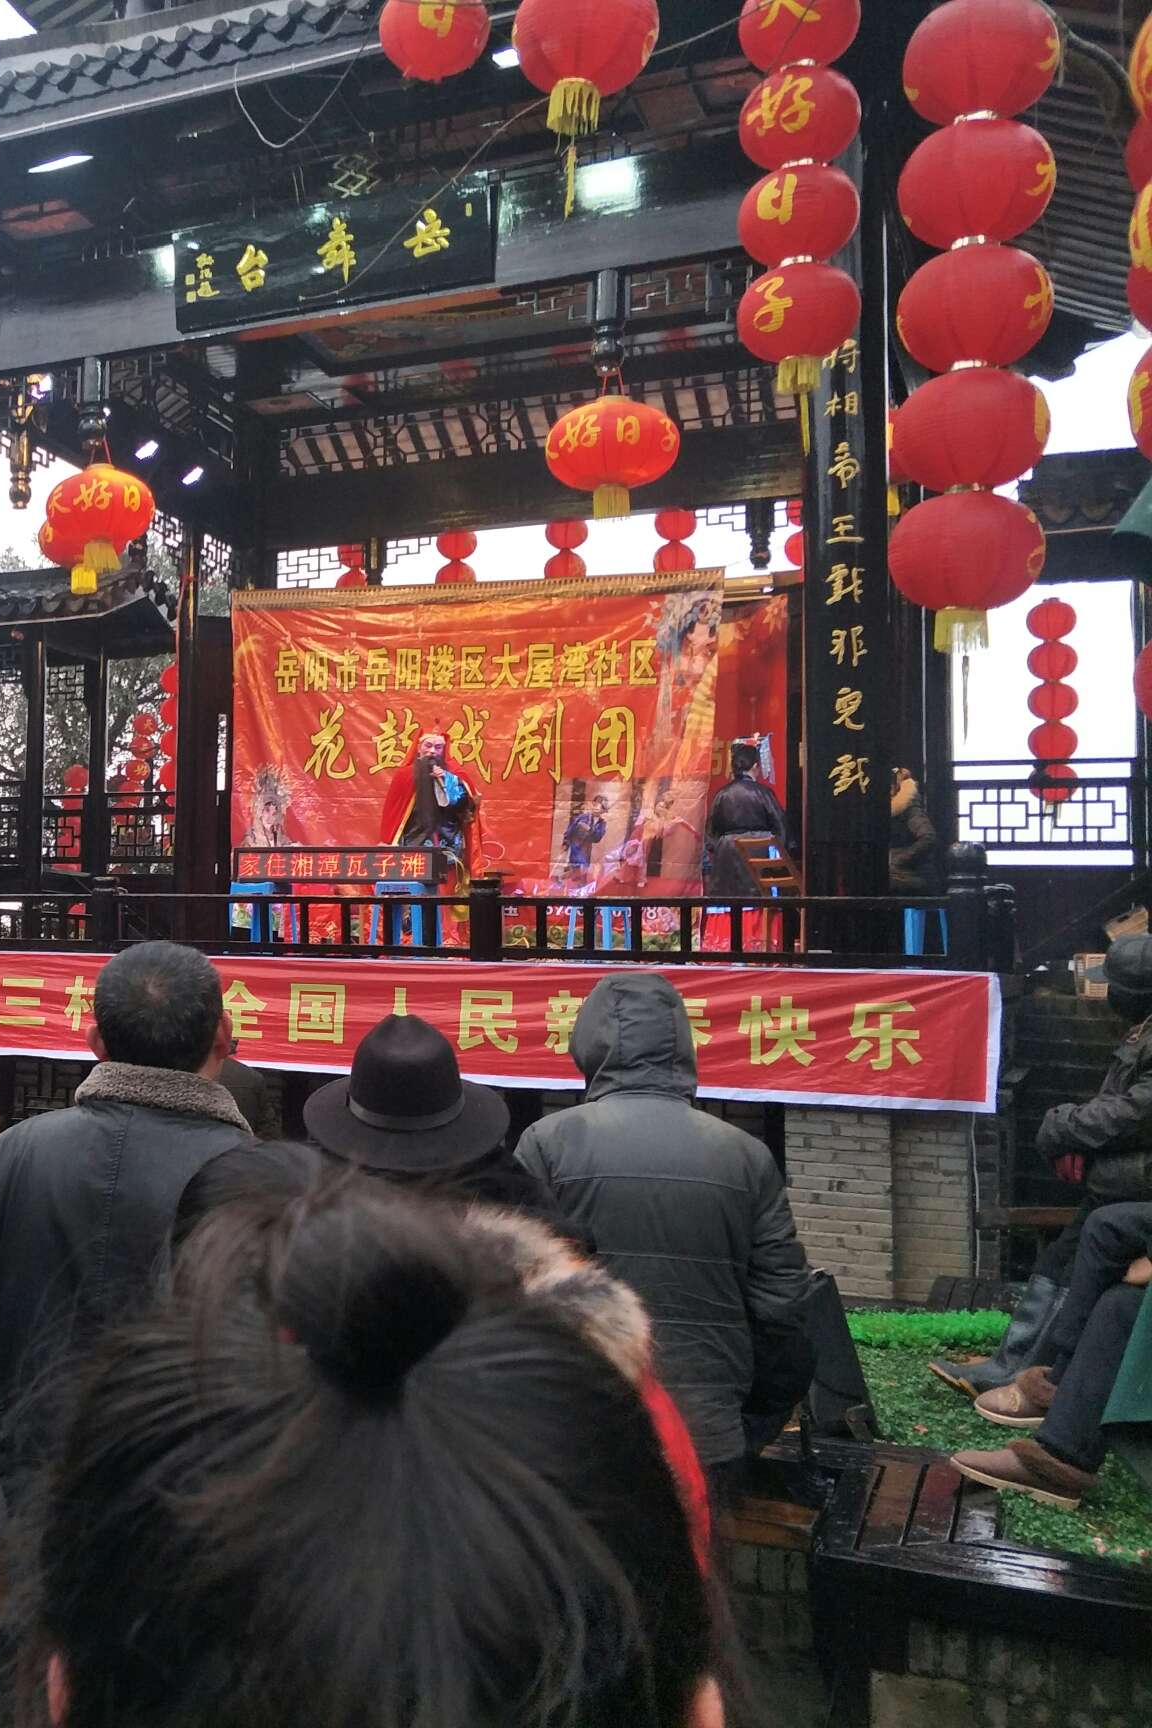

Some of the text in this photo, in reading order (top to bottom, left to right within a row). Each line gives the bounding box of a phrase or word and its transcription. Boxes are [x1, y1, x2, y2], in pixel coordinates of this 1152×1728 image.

[274, 639, 658, 694] 岳阳市岳阳楼区大屋湾社区
[303, 698, 637, 784] 花鼓戏剧团
[239, 852, 426, 879] 家住湘潭瓦子滩
